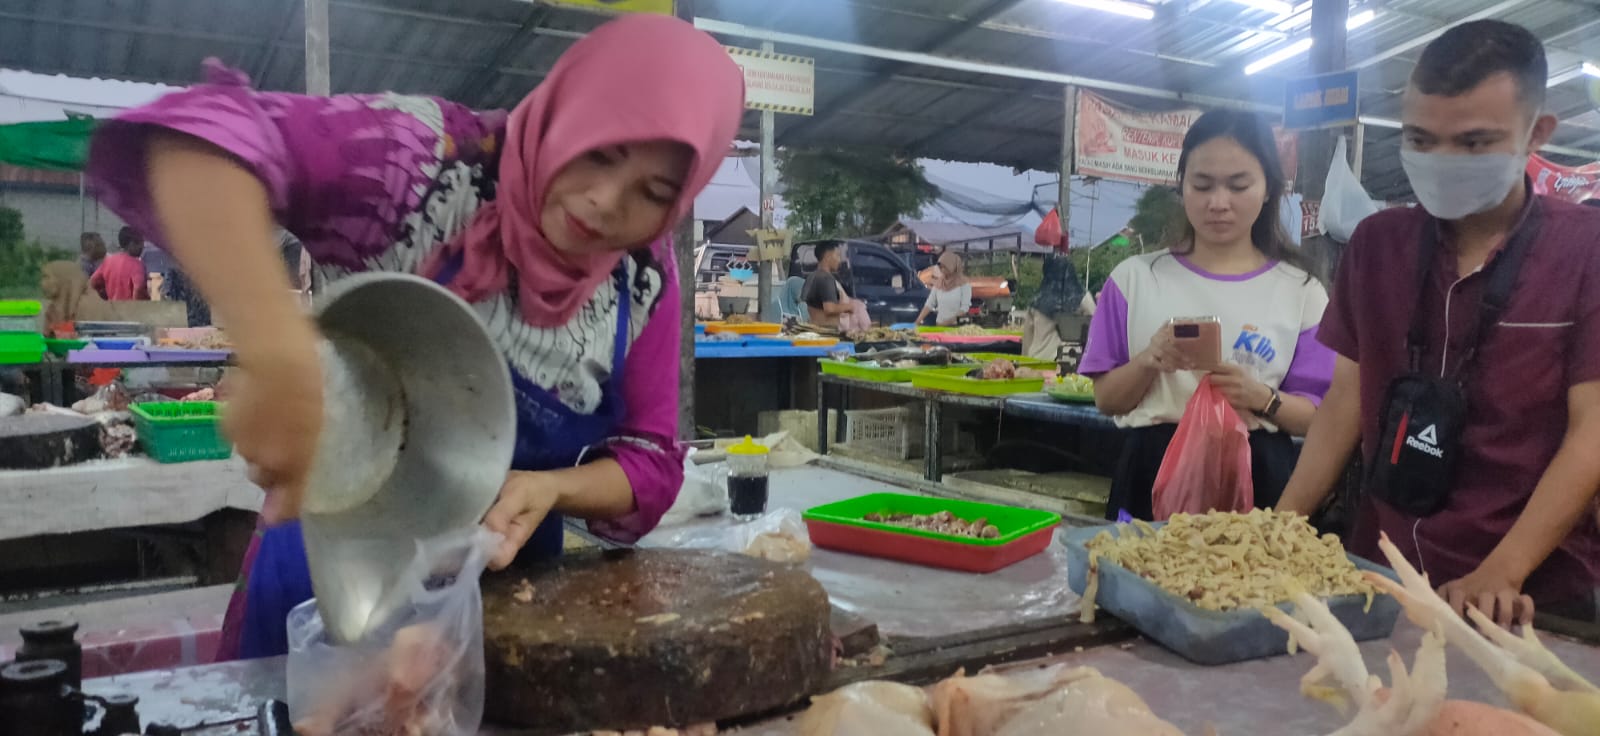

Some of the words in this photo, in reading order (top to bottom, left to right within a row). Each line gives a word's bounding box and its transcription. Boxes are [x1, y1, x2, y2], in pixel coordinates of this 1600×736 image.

[1111, 161, 1123, 170] ADA
[1124, 145, 1158, 163] MASUK
[1161, 151, 1176, 165] KE
[1233, 330, 1276, 363] Klin
[1406, 435, 1444, 459] Reebok
